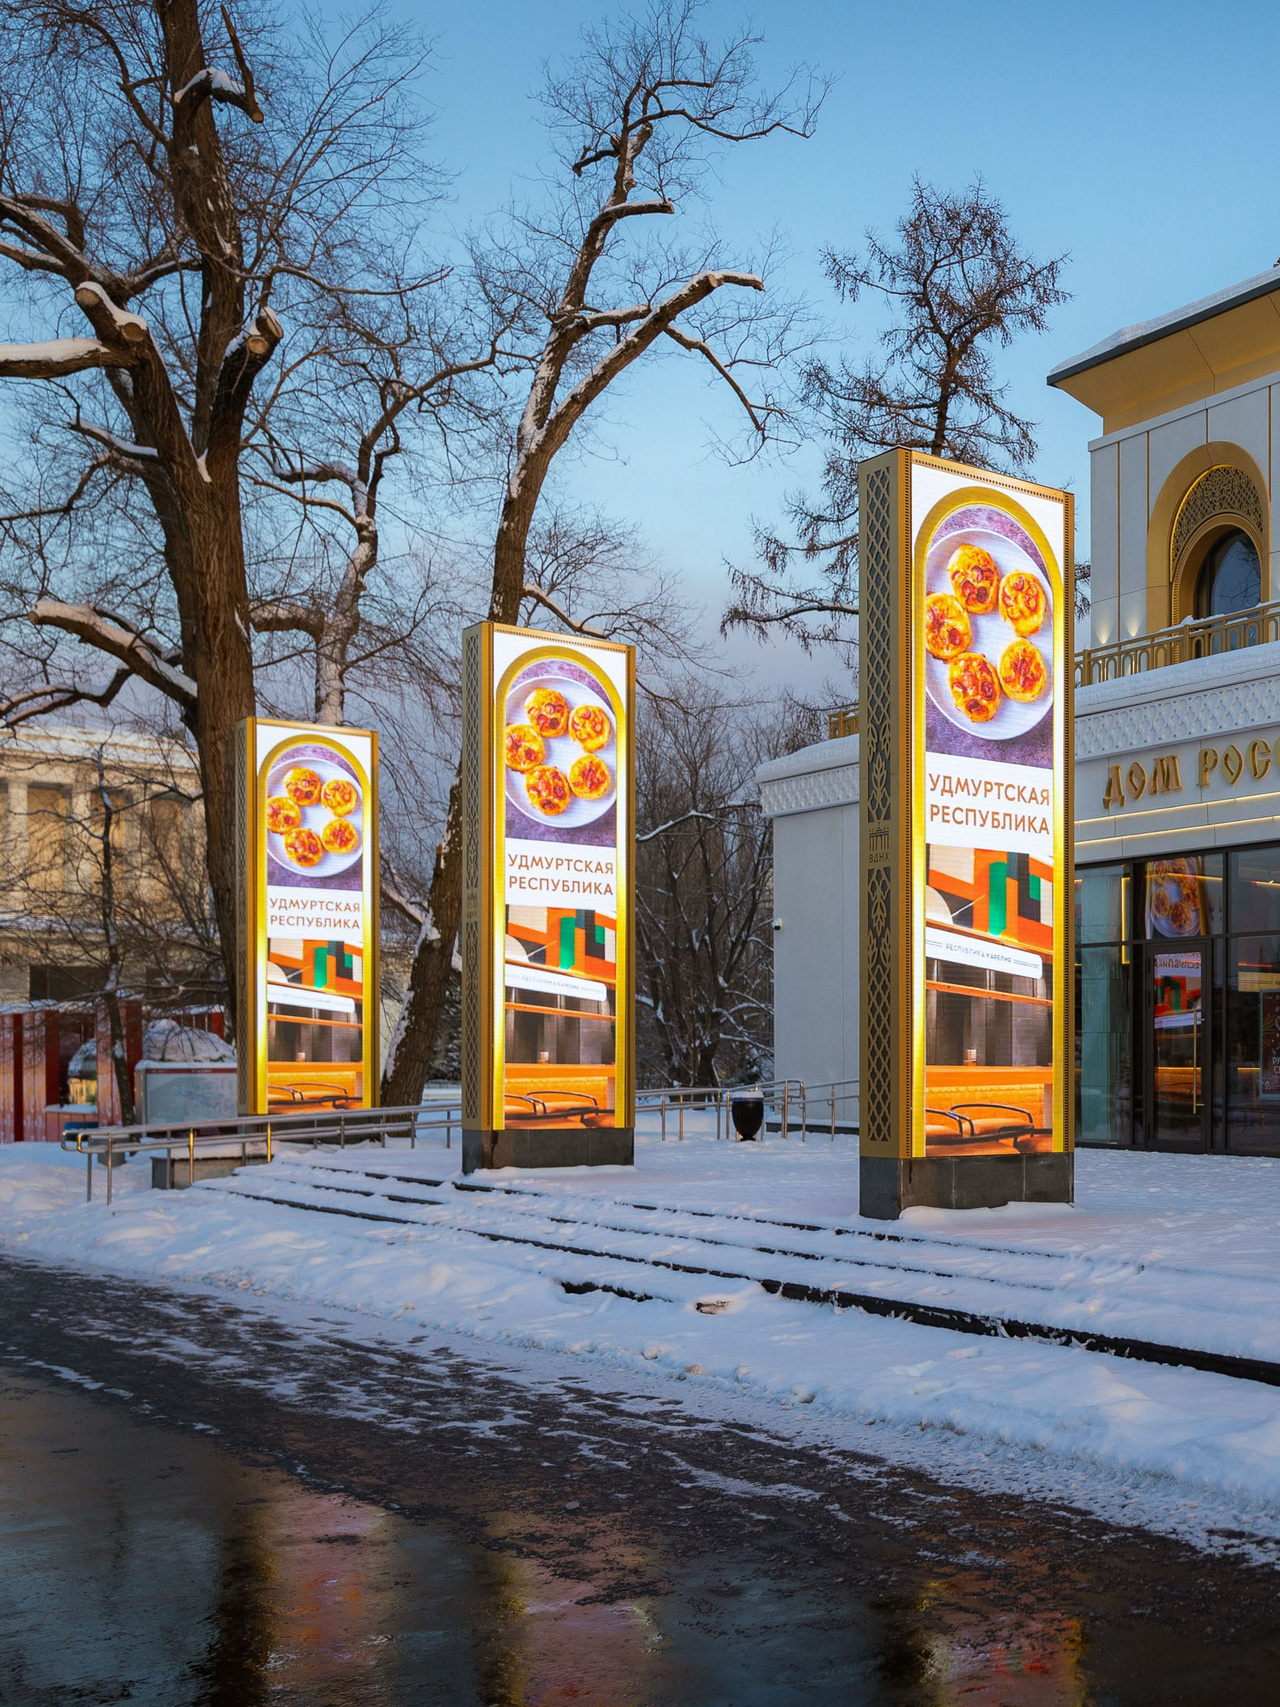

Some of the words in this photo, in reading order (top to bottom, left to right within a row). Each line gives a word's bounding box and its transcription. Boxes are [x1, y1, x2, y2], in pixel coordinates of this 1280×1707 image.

[929, 773, 1050, 806] УДМУРТСКАЯ
[1103, 753, 1183, 810] ДОМ
[930, 804, 1050, 835] РЕСПУБЛИКА
[508, 854, 613, 875] УДМУРТСКАЯ
[869, 852, 889, 864] ВДНХ
[509, 875, 613, 896] РЕСПУБЛИКА
[269, 898, 360, 913] УДМУРТСКАЯ
[270, 915, 360, 929] РЕСПУБЛИКА
